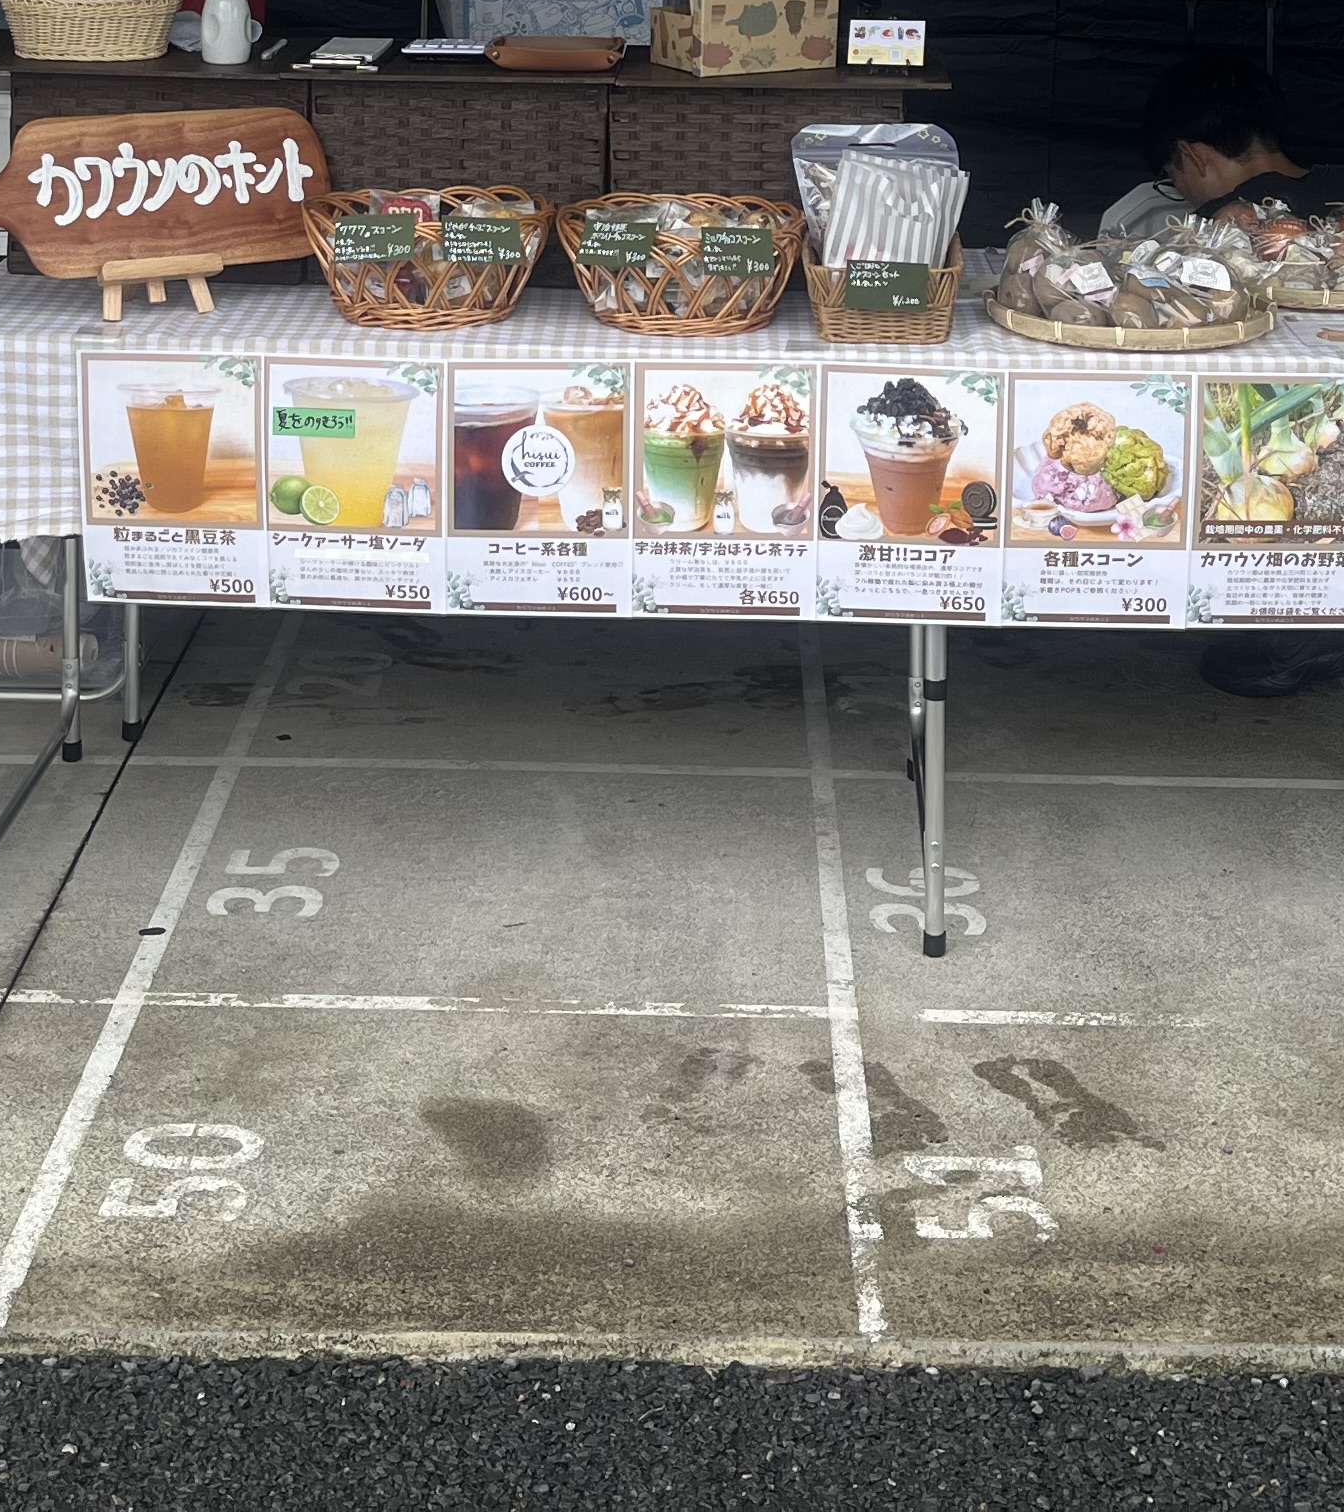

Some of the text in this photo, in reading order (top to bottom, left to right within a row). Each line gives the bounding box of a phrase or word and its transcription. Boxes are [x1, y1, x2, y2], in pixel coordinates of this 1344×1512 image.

[28, 138, 314, 227] カワウソのホント
[113, 526, 237, 546] 粒まるごと黒豆茶
[272, 532, 427, 552] シークァーサー塩ソーダ
[488, 541, 588, 557] コーヒー系各種
[858, 544, 956, 564] 激甘!!ココア
[1043, 551, 1144, 568] 各種スコーン
[209, 579, 254, 593] ¥500
[385, 584, 430, 600] ¥550
[739, 589, 800, 605] 各¥650
[940, 596, 985, 611] ¥650
[1121, 597, 1167, 612] ¥300
[204, 846, 341, 920] 35
[97, 1121, 264, 1223] 50
